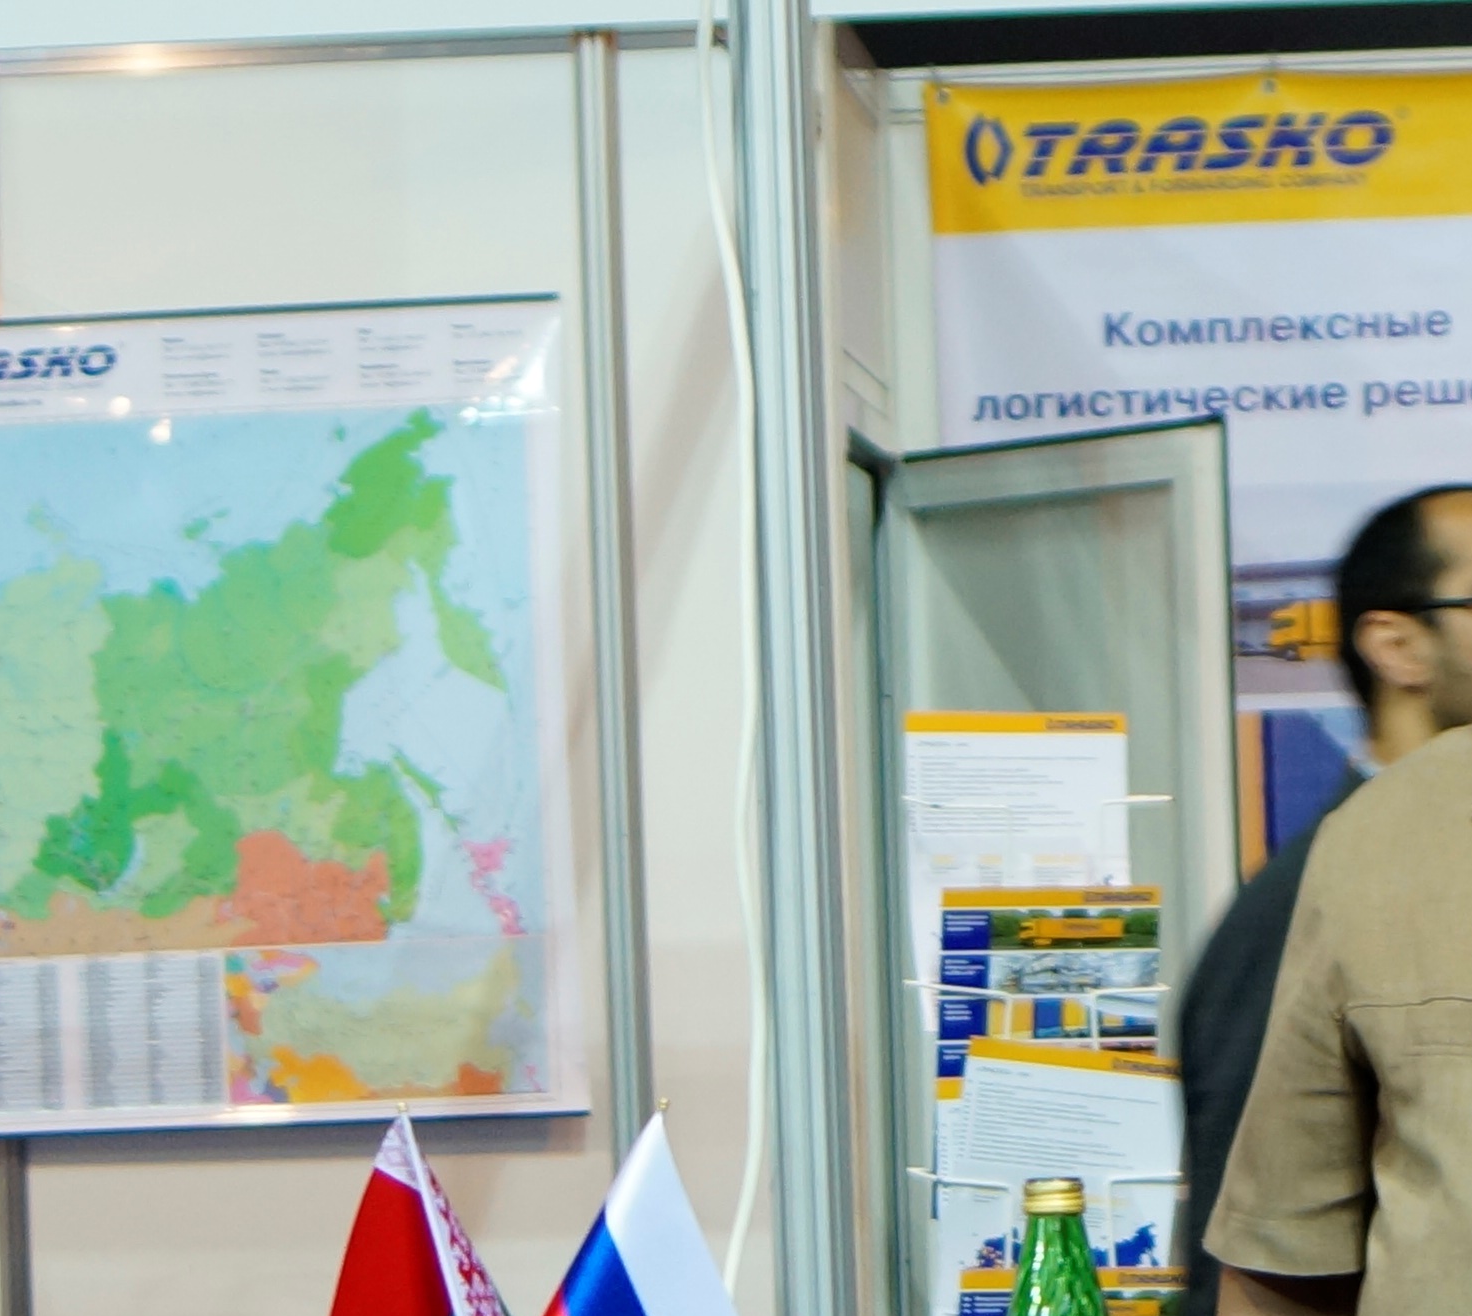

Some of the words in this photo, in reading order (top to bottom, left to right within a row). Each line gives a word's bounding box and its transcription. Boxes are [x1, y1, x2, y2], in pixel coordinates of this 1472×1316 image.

[1021, 109, 1395, 178] TRASKO
[1103, 308, 1453, 348] Комплексные
[973, 378, 1348, 424] логистические
